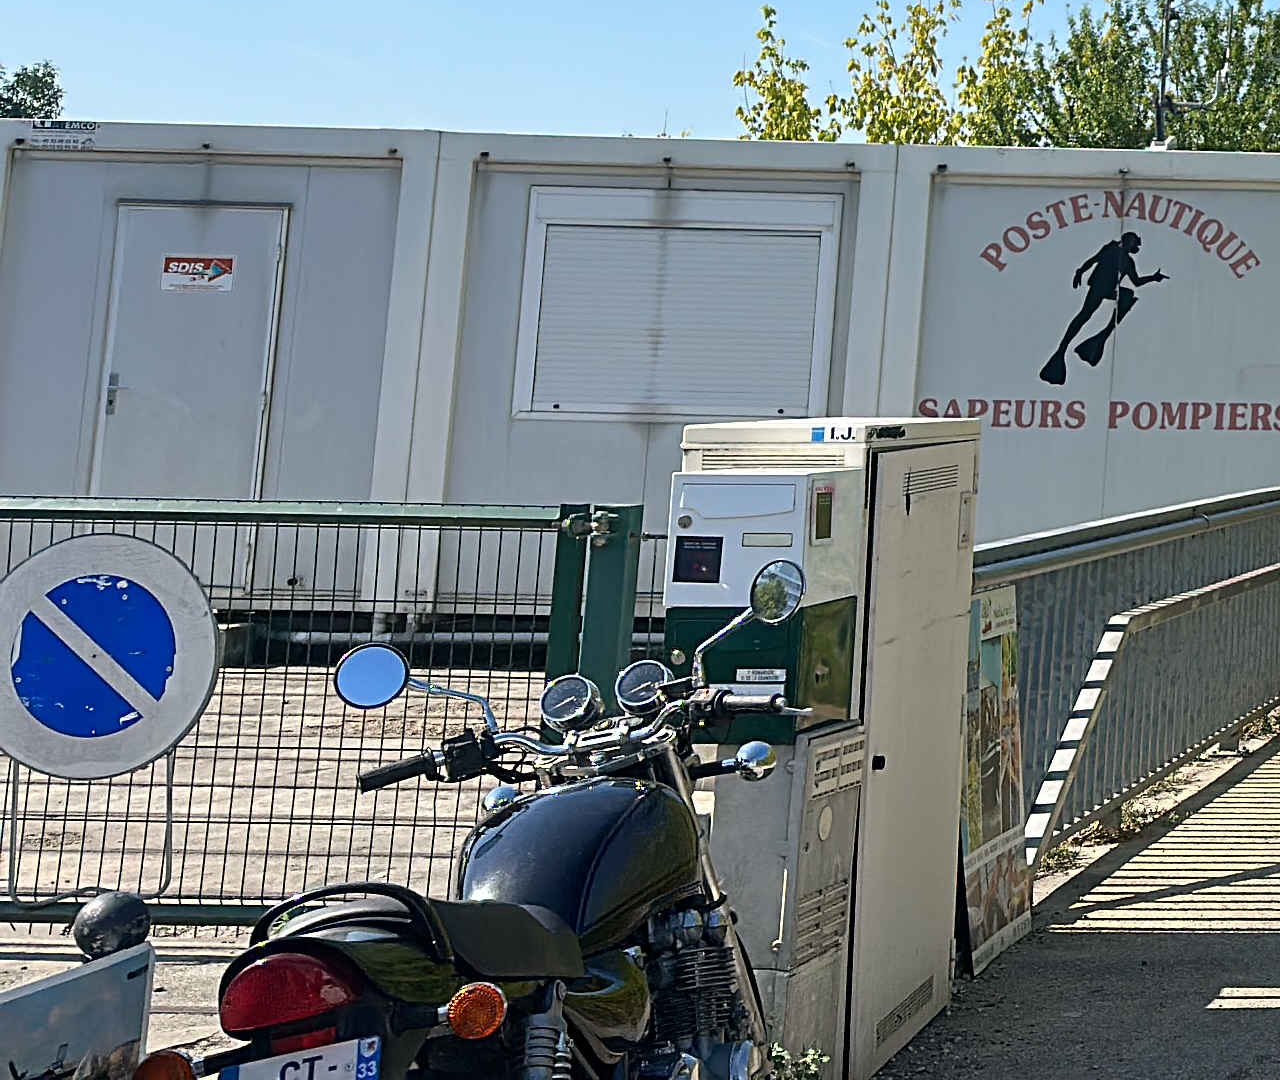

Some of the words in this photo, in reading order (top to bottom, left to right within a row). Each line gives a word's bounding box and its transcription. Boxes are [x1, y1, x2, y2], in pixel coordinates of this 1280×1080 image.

[980, 192, 1094, 273] POSTE
[1101, 190, 1262, 280] NAUTIQUE
[167, 261, 205, 273] SDIS
[918, 398, 1087, 430] SAPEURS
[357, 1060, 378, 1079] 33
